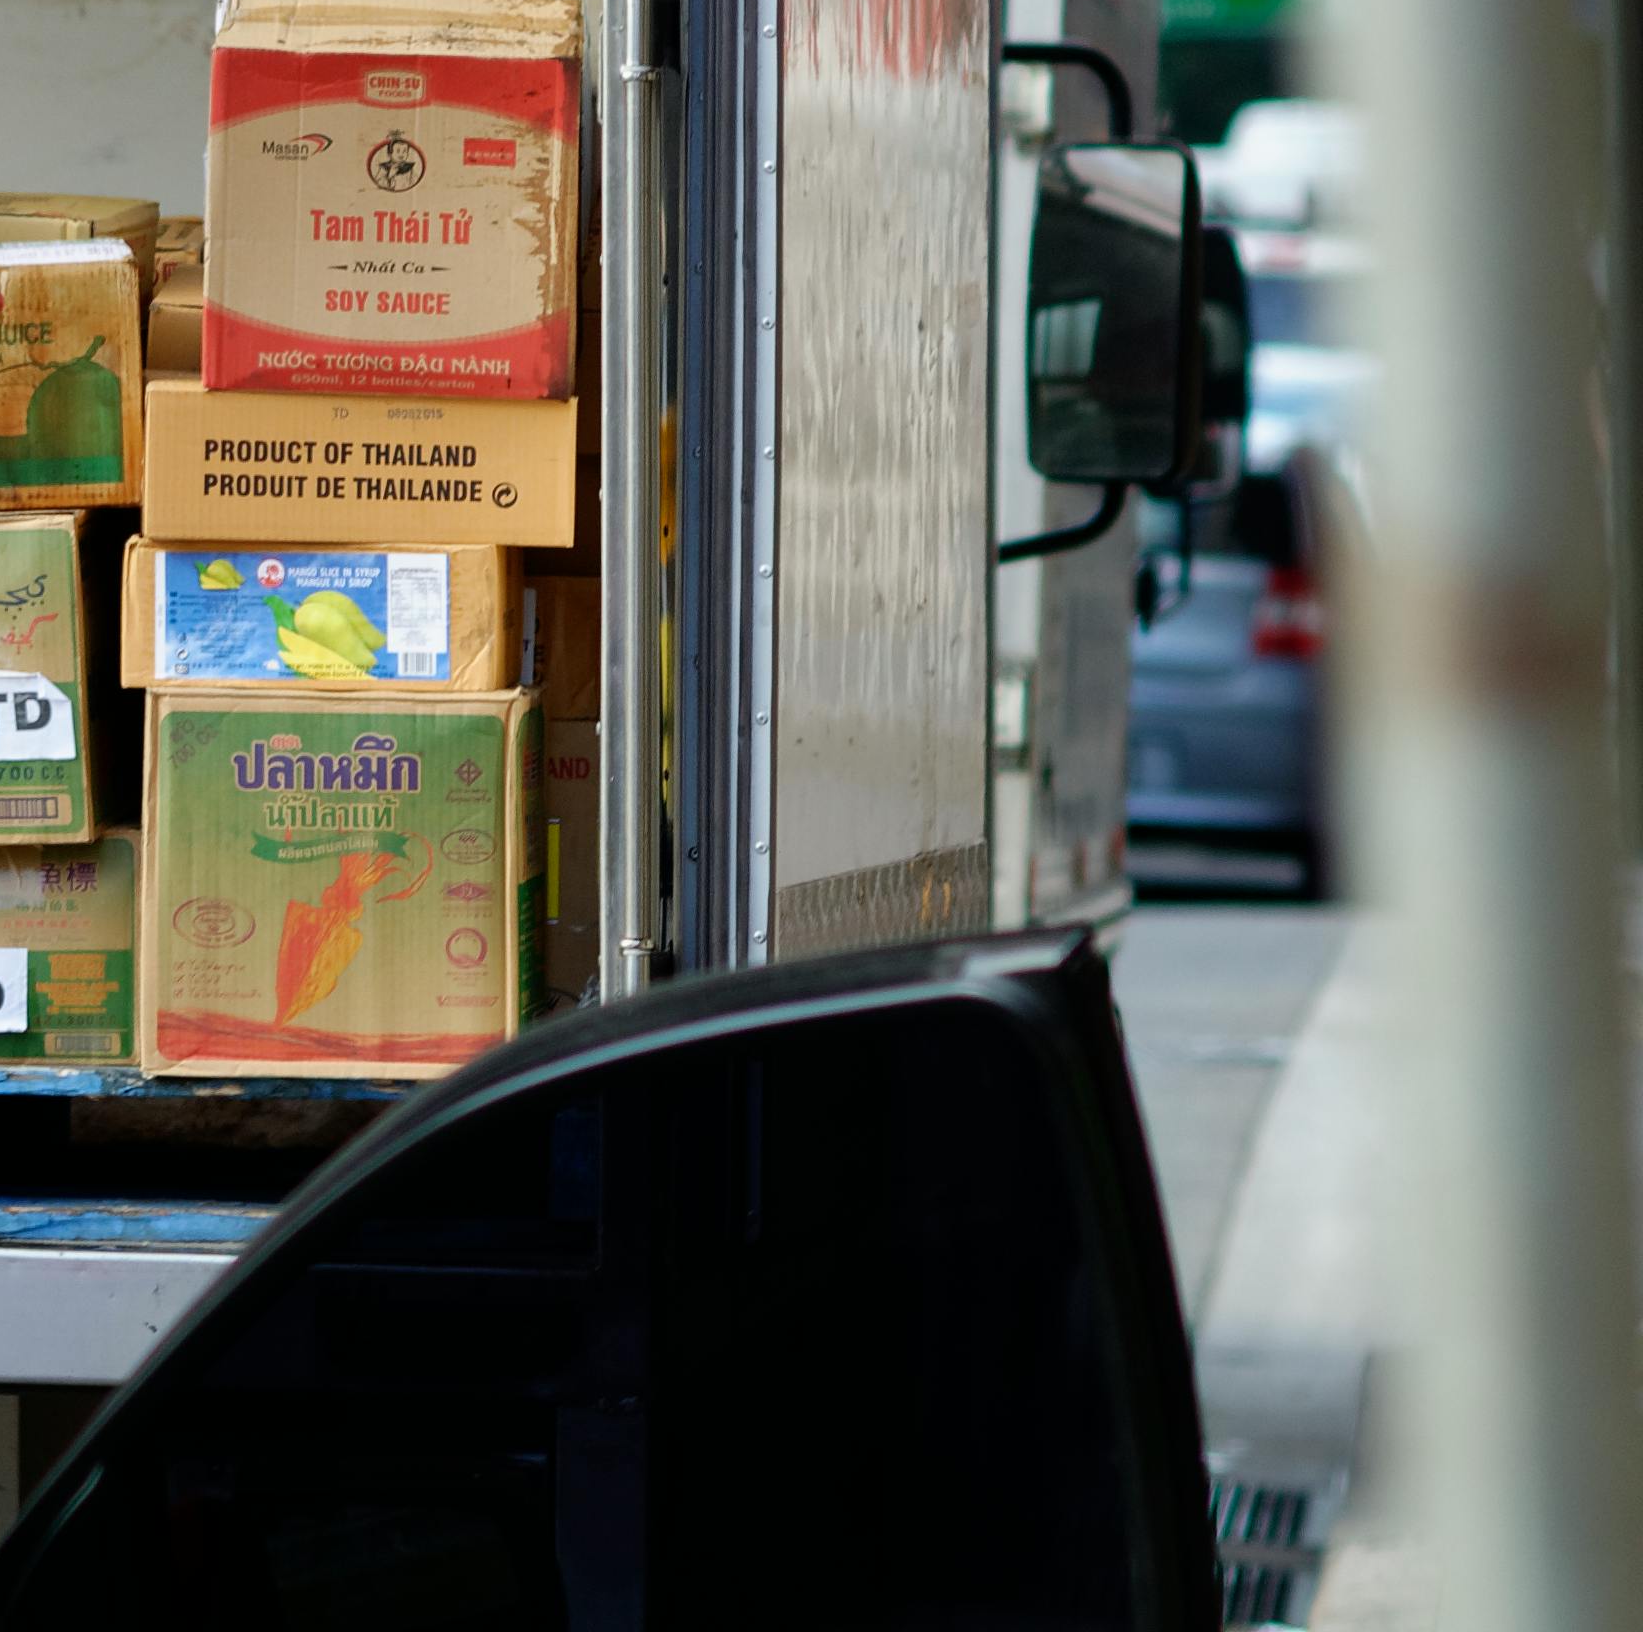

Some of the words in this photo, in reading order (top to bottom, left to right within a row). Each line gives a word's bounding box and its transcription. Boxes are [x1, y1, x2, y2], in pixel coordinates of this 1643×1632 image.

[263, 141, 309, 154] Masan
[310, 209, 364, 243] Tam
[374, 211, 429, 245] Thái
[440, 207, 472, 245] Tử
[325, 290, 368, 312] SOY
[377, 291, 451, 315] SAUCE
[205, 439, 315, 464] PRODUCT
[324, 441, 353, 465] OF
[363, 443, 477, 467] THAILAND
[204, 474, 309, 498] PRODUIT
[316, 477, 345, 499] DE
[353, 477, 483, 502] THAILANDE
[232, 734, 421, 792] ปลาหมึก
